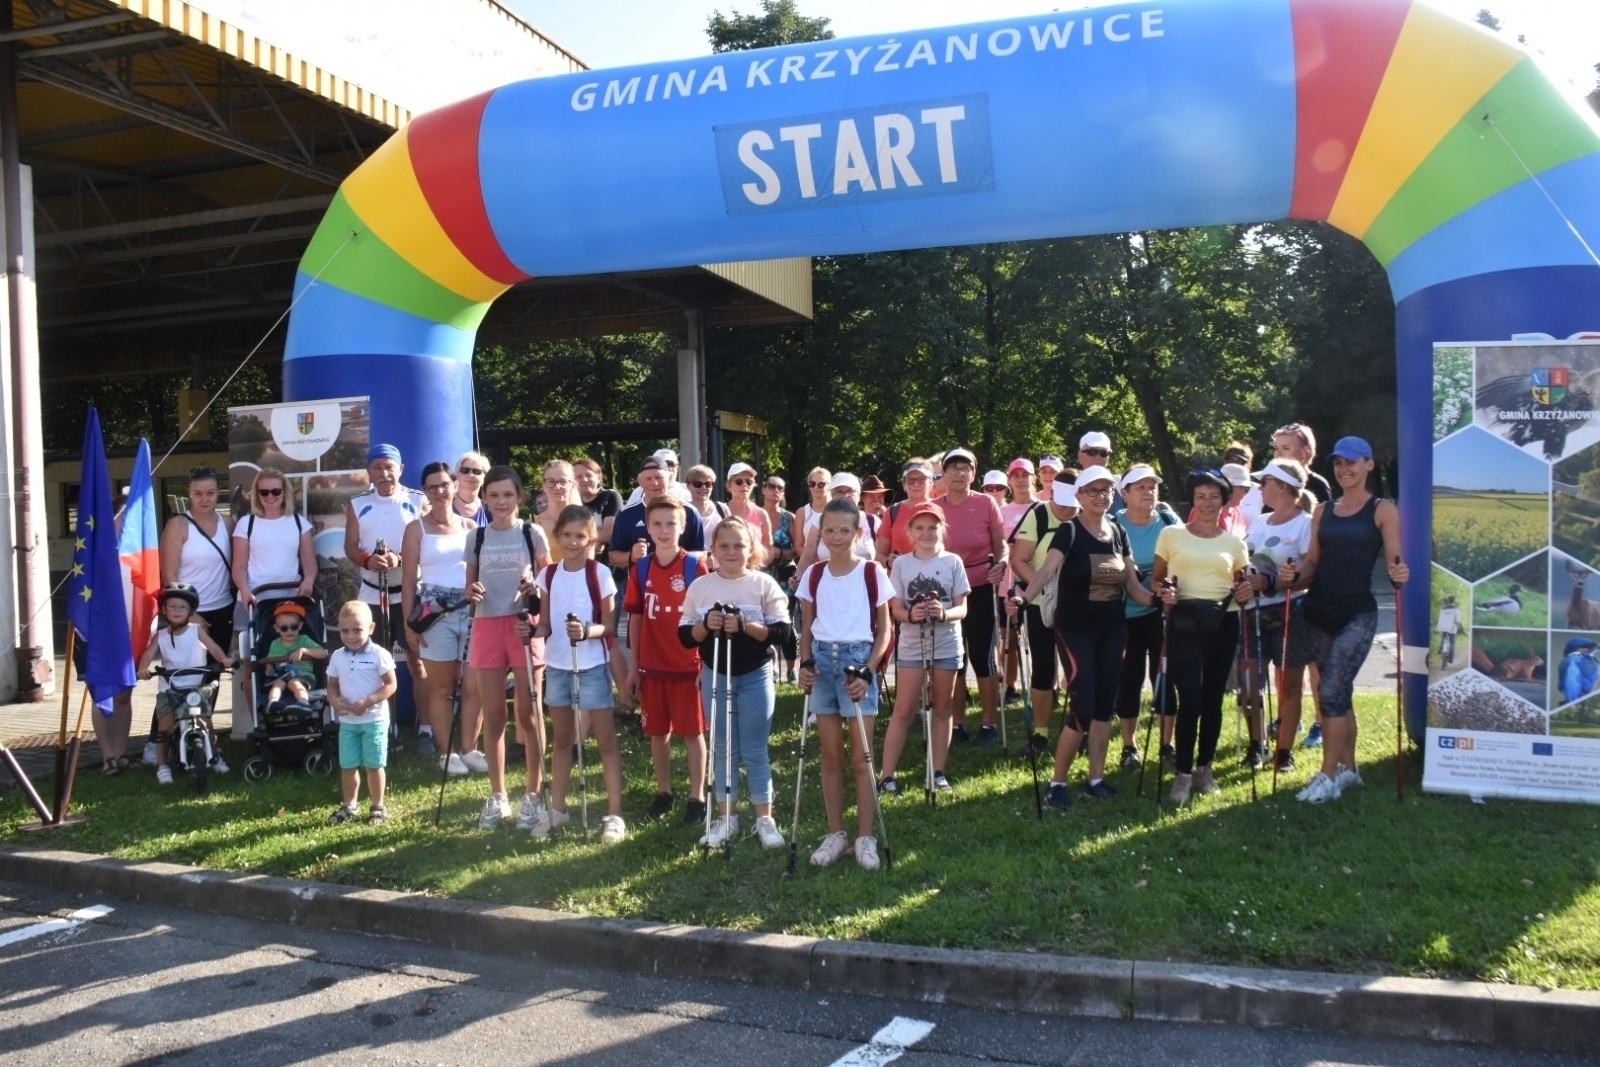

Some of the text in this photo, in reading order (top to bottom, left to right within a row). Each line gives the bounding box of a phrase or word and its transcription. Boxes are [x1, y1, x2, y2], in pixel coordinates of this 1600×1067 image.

[570, 9, 1167, 113] GMINA KRZYŻANOWICE
[737, 104, 967, 206] START
[1499, 411, 1530, 420] GMINA
[1440, 737, 1455, 747] cz
[1458, 738, 1472, 750] pl
